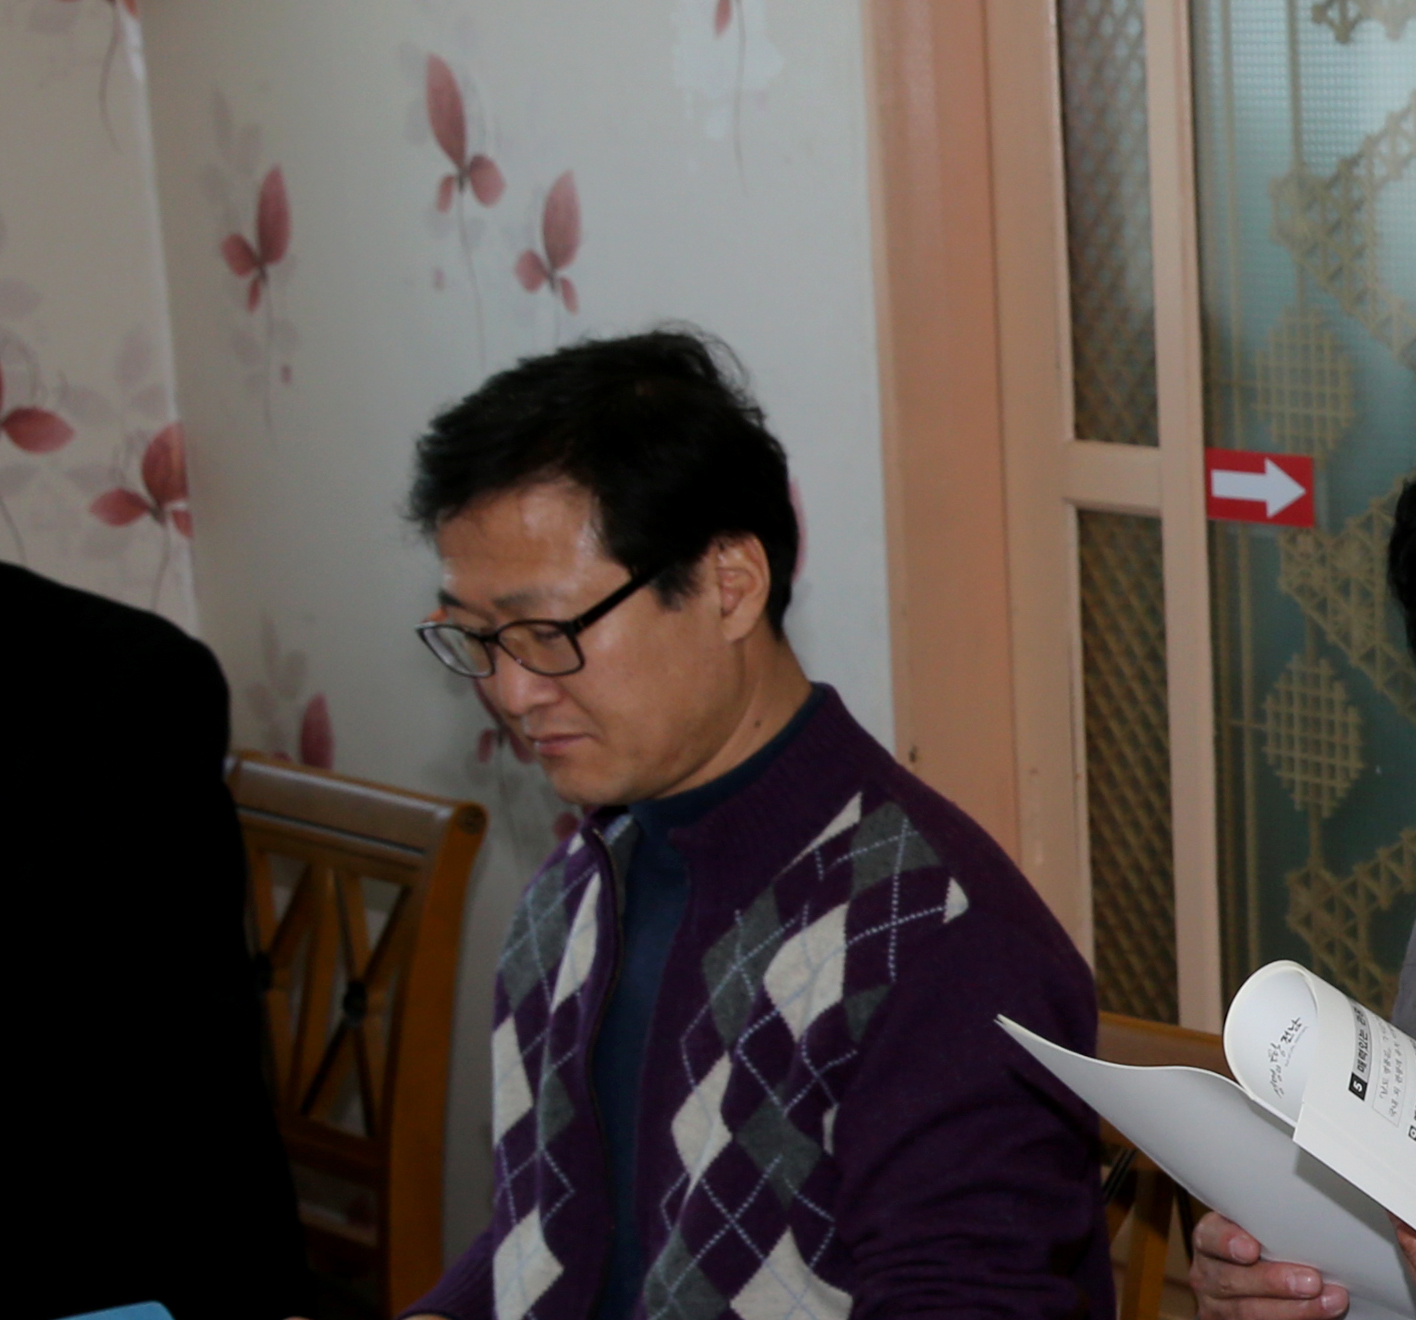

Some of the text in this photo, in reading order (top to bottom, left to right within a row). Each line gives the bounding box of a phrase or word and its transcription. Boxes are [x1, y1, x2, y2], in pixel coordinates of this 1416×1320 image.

[1280, 1017, 1302, 1044] 전남
[1353, 1029, 1368, 1091] 5 매력있는
